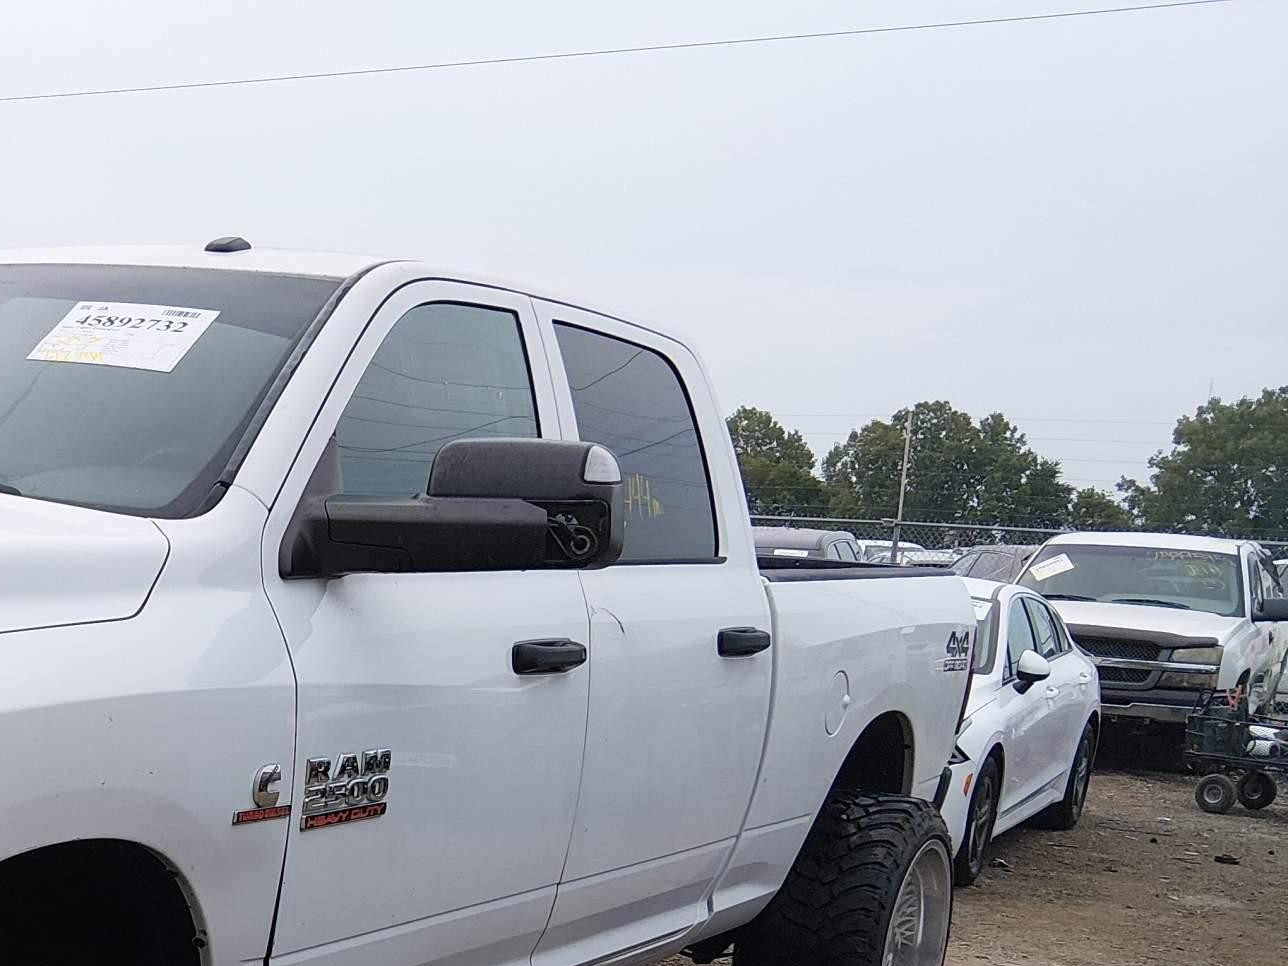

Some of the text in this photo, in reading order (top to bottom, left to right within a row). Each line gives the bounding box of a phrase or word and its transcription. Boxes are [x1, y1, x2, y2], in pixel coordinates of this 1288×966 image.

[75, 314, 189, 333] 45892732
[305, 748, 392, 786] RAM
[303, 774, 389, 812] 2500
[306, 803, 385, 829] HEAVY DUTY
